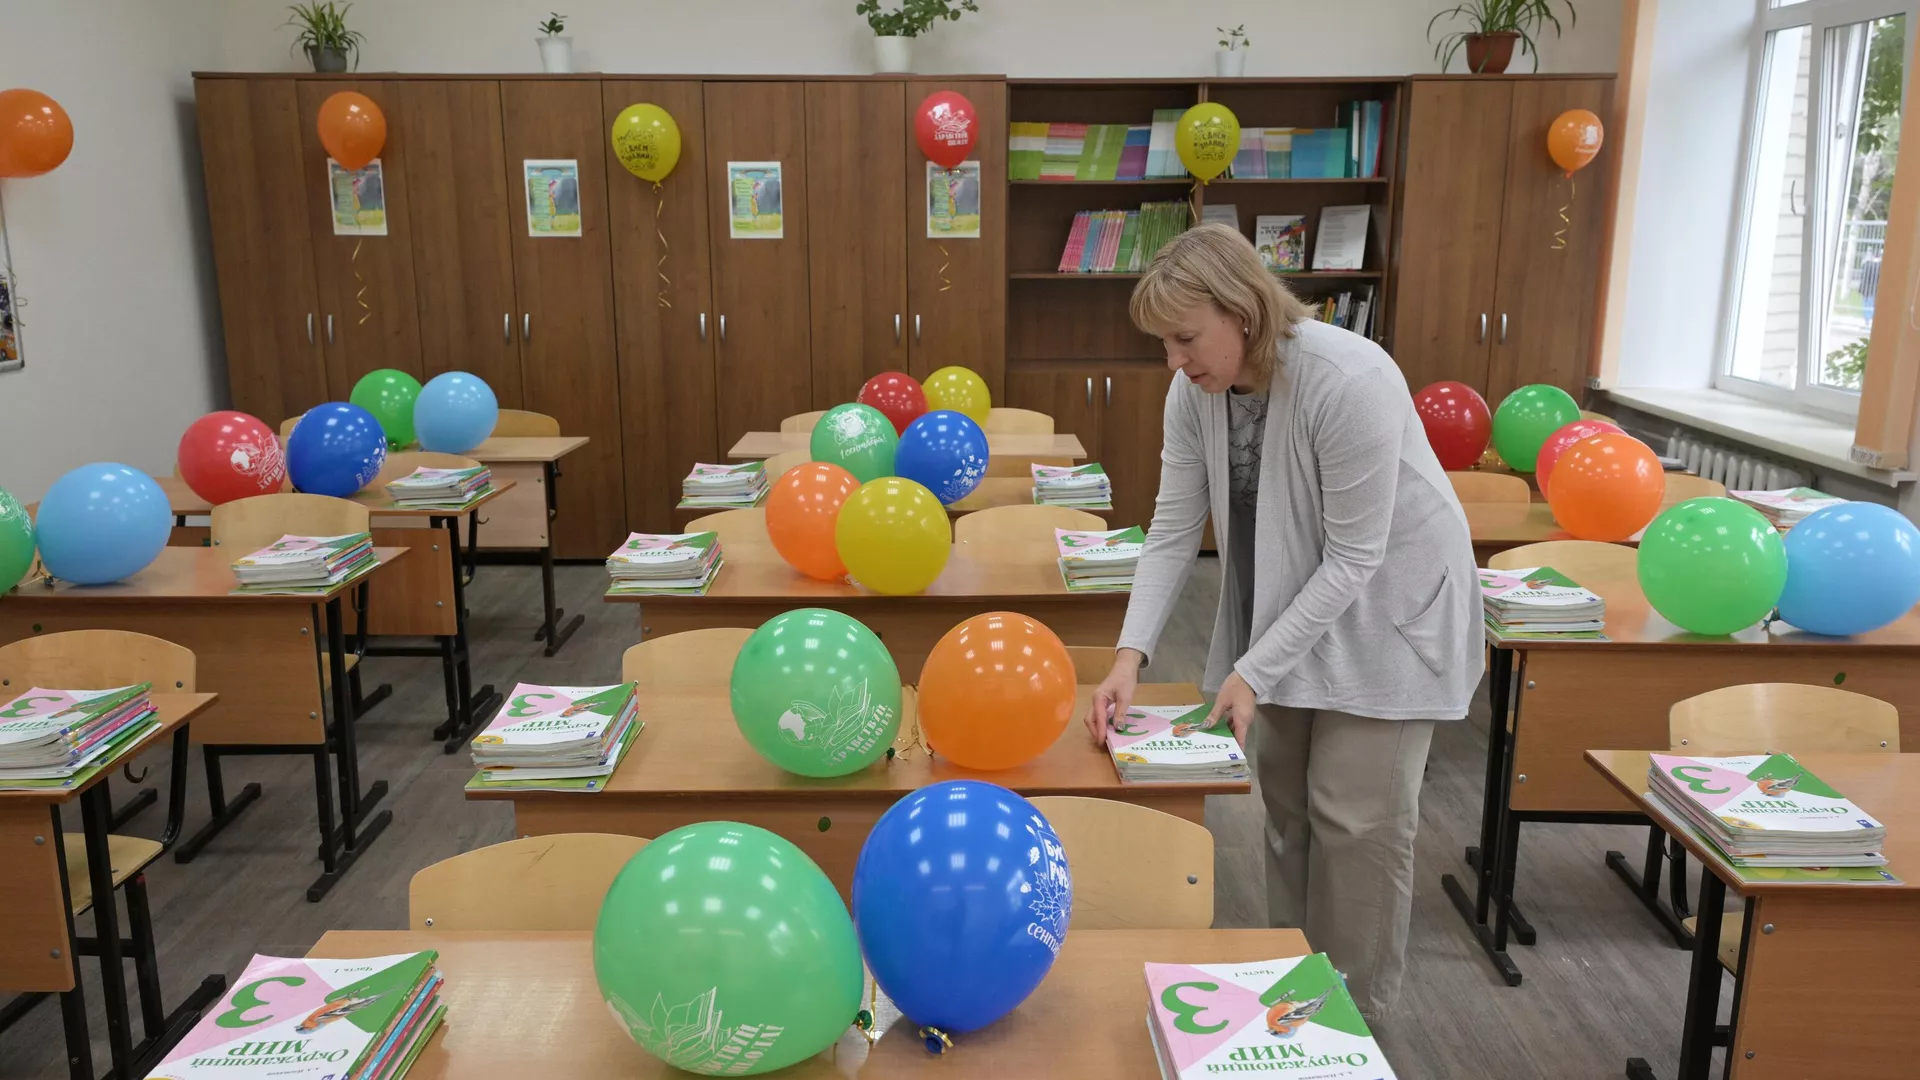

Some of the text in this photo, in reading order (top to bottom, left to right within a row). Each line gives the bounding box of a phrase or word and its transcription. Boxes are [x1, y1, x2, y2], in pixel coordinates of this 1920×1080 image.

[507, 693, 555, 718] 3
[1671, 765, 1731, 794] 3
[1741, 800, 1798, 809] МИР
[215, 976, 306, 1028] 3
[1161, 981, 1230, 1034] 3
[189, 1048, 349, 1068] Окружающий
[227, 1038, 313, 1056] МИР
[1228, 1043, 1309, 1061] МИР
[1206, 1052, 1368, 1075] Окружающий
